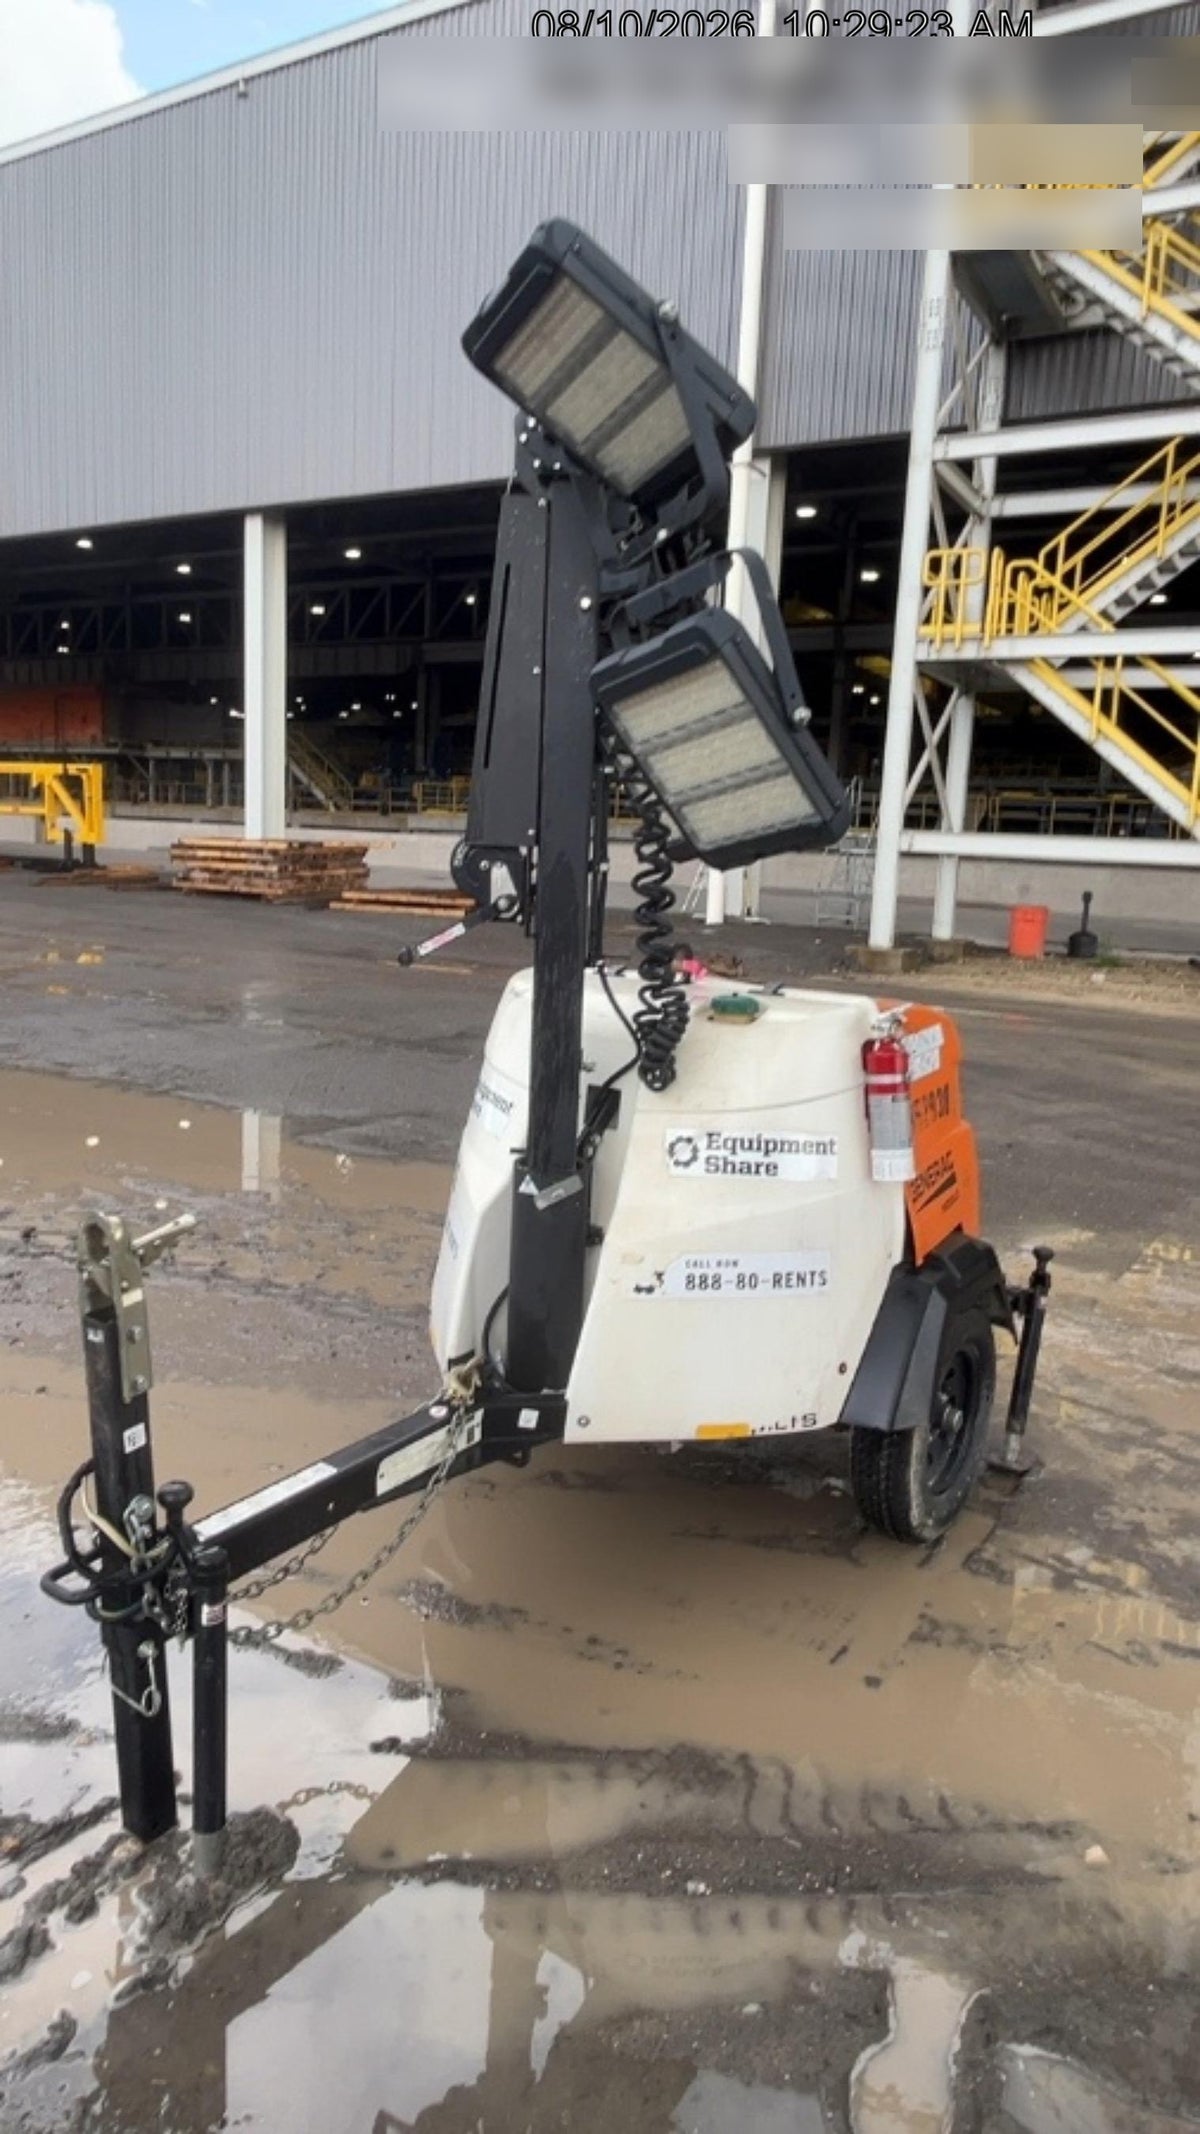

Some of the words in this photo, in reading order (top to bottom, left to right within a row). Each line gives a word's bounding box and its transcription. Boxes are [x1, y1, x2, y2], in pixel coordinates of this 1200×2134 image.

[705, 1131, 837, 1157] Equipment
[704, 1154, 779, 1177] Share
[685, 1258, 711, 1269] CALL
[715, 1258, 740, 1269] NOW
[684, 1269, 829, 1291] 888-80-RENTS
